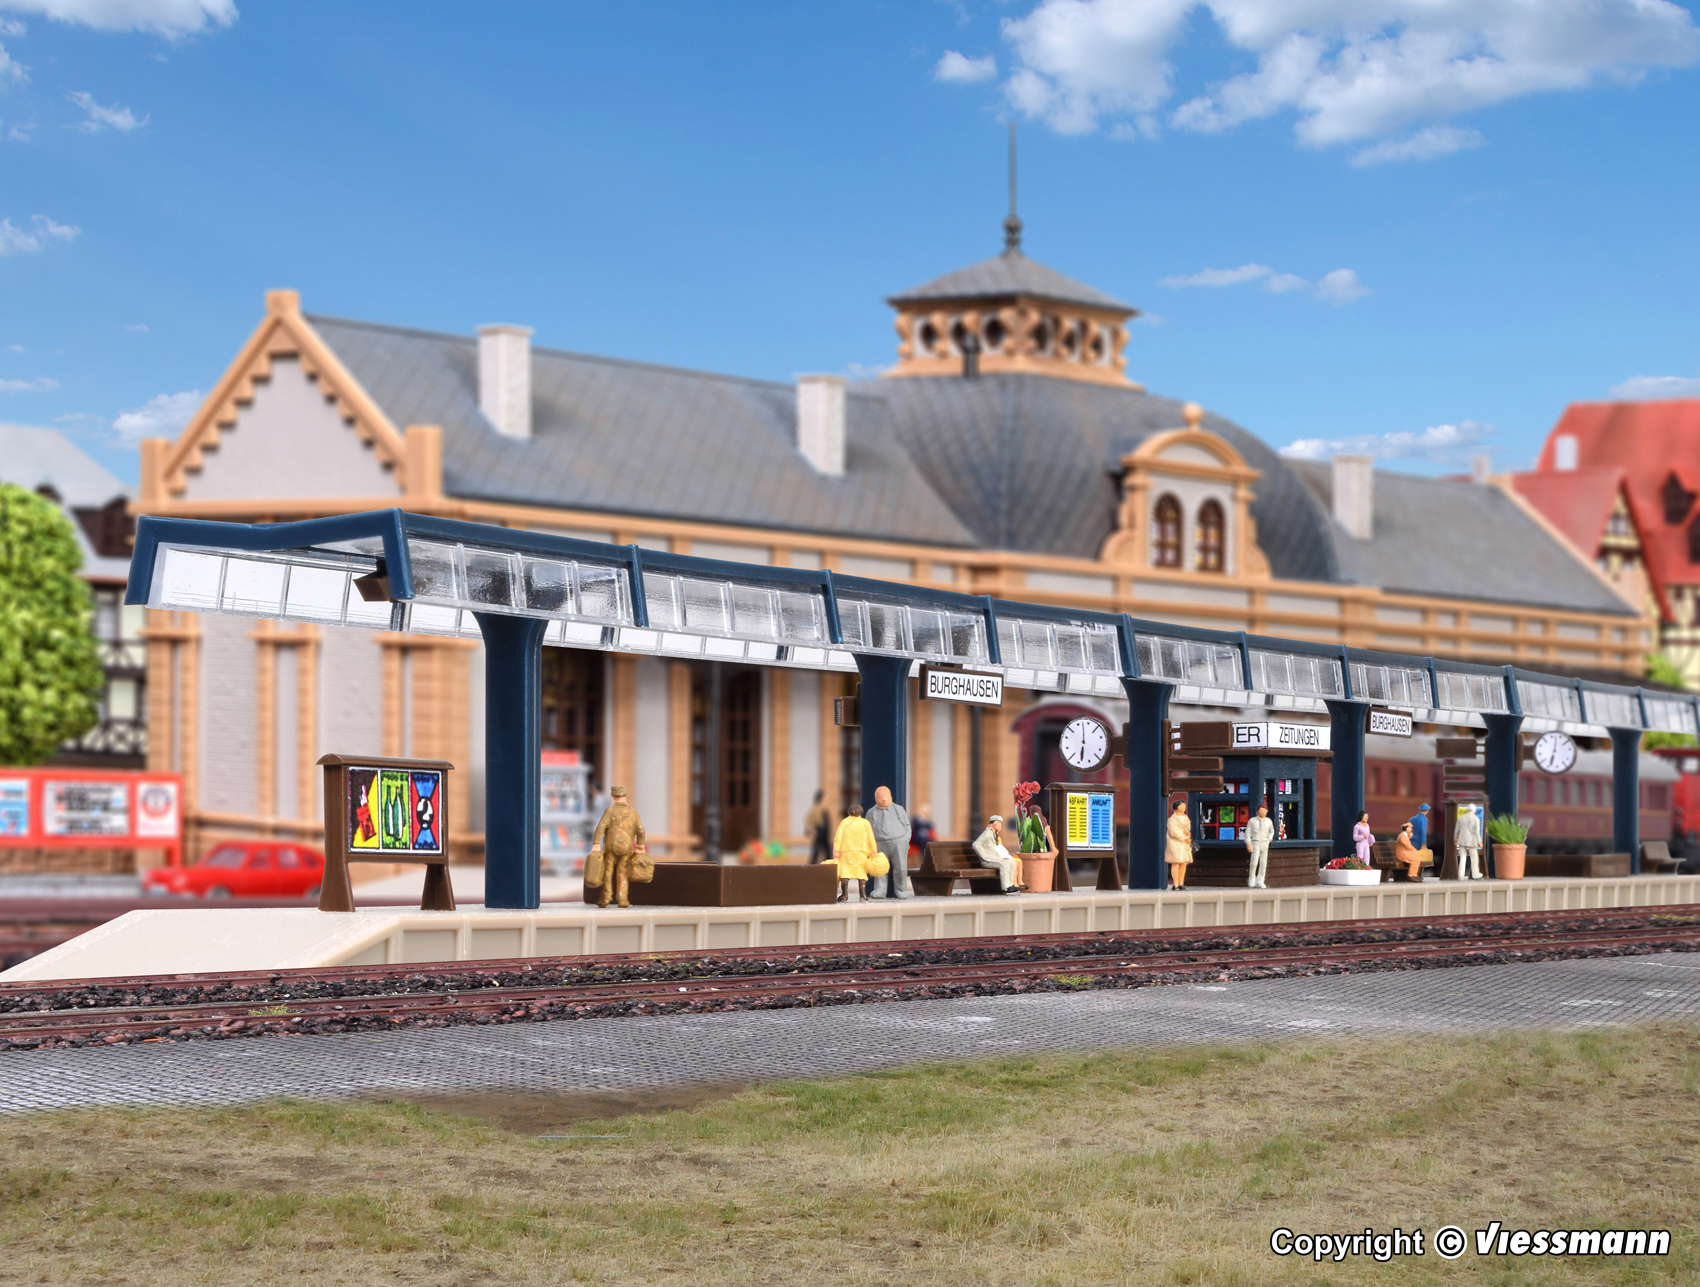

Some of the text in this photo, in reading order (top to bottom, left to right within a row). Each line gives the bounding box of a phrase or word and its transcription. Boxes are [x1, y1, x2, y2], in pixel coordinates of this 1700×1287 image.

[930, 675, 998, 698] BURGHAUSEN
[1372, 714, 1410, 732] BURGHAUSEN
[1232, 726, 1261, 743] ER
[1279, 726, 1320, 745] ZEITUNGEN
